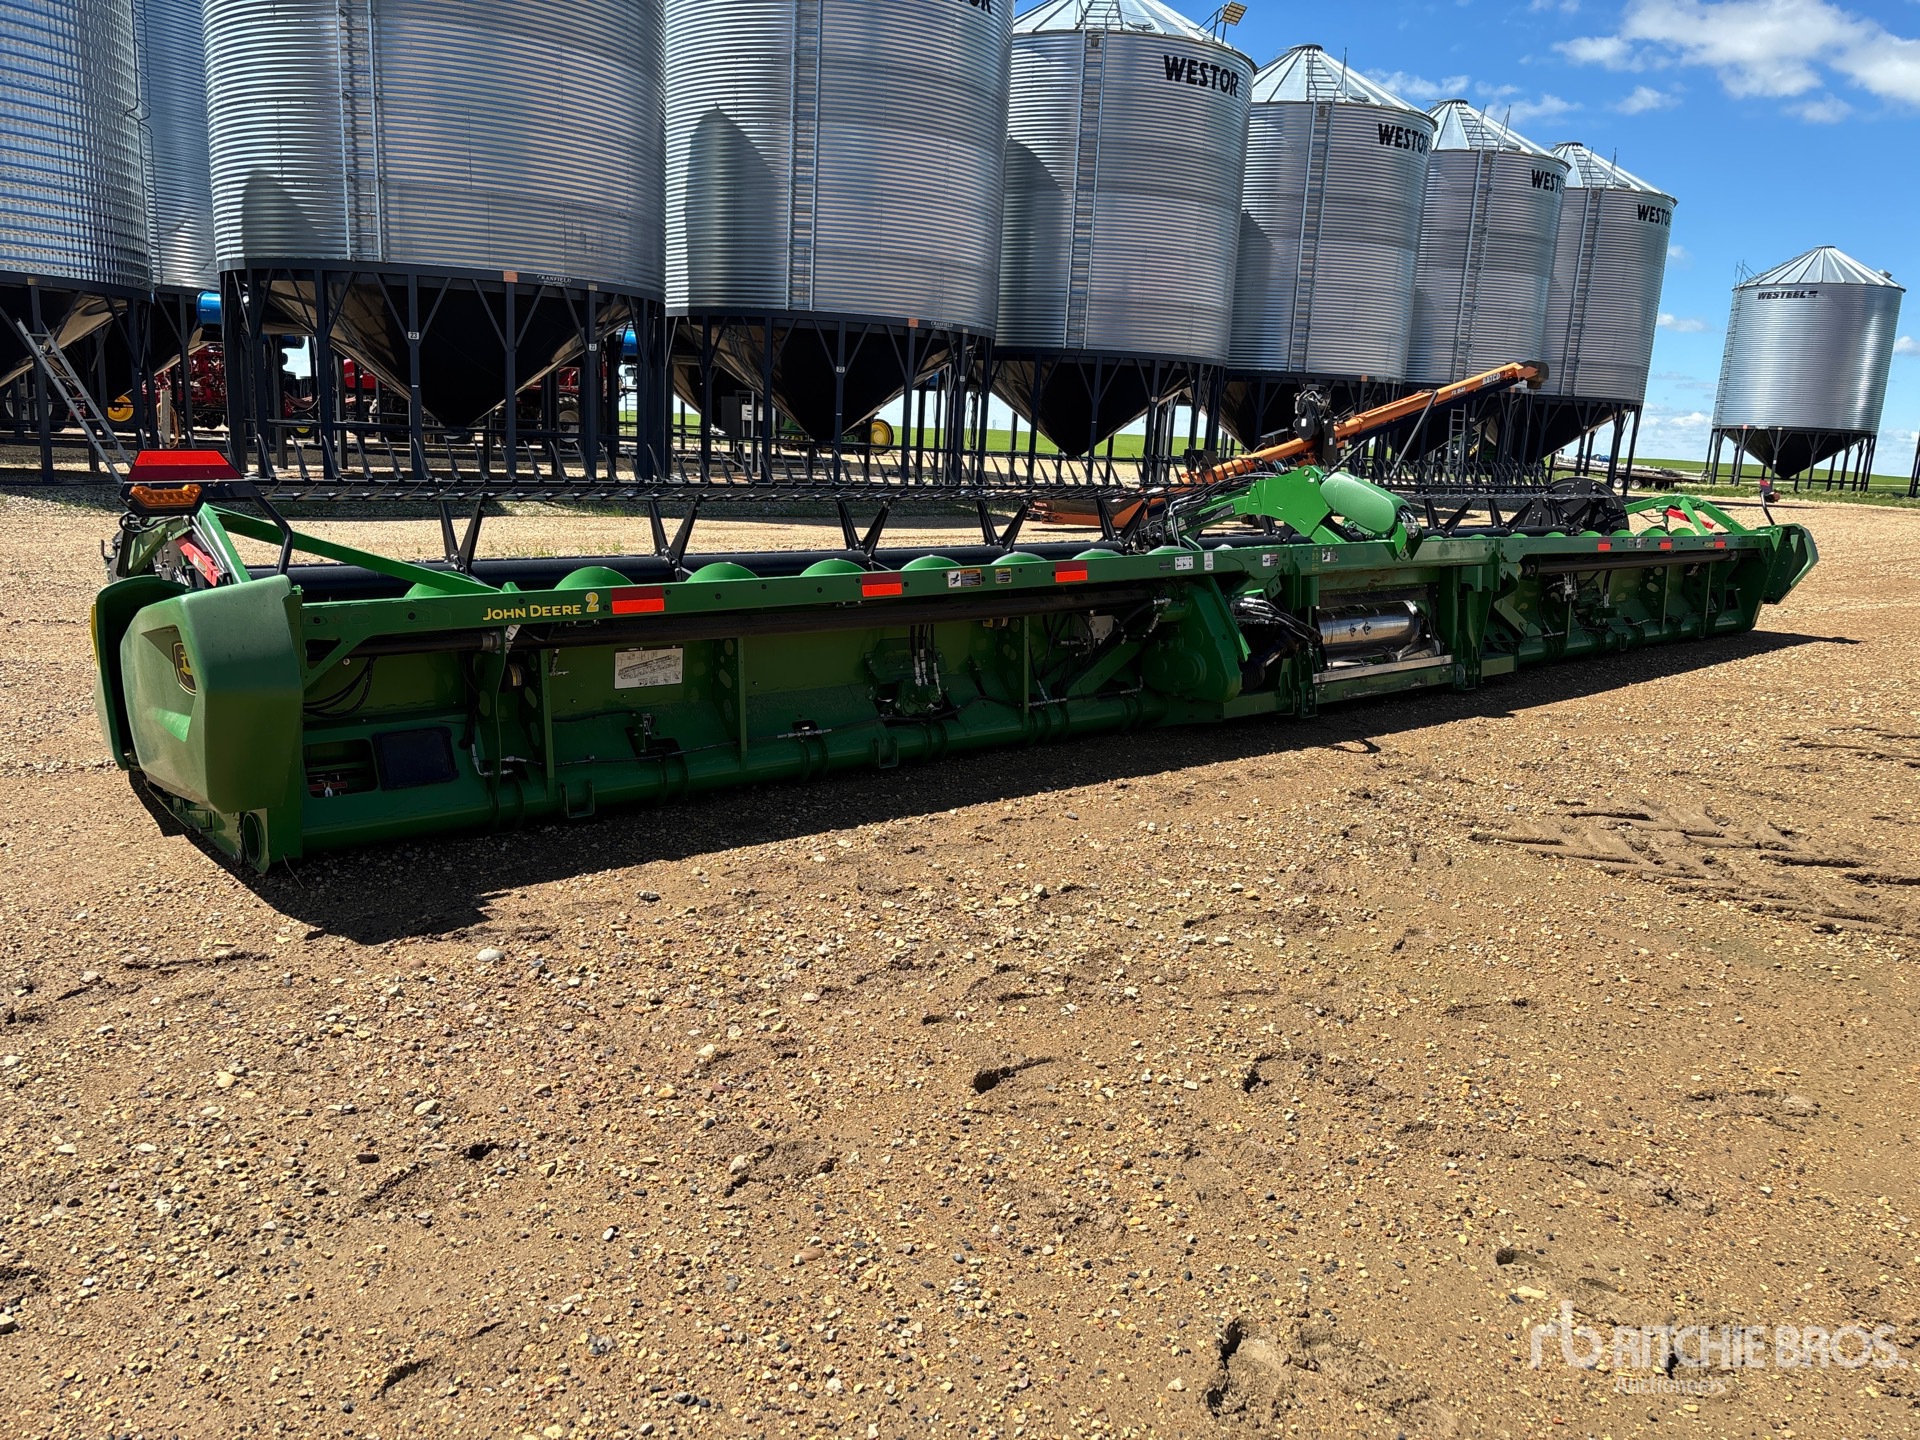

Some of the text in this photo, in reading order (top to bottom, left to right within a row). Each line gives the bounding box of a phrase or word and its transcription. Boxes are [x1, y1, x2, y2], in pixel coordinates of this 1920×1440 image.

[1163, 55, 1239, 98] WESTOR
[1757, 290, 1806, 300] WESTEEL
[482, 607, 527, 621] JOHN
[529, 604, 582, 617] DEERE
